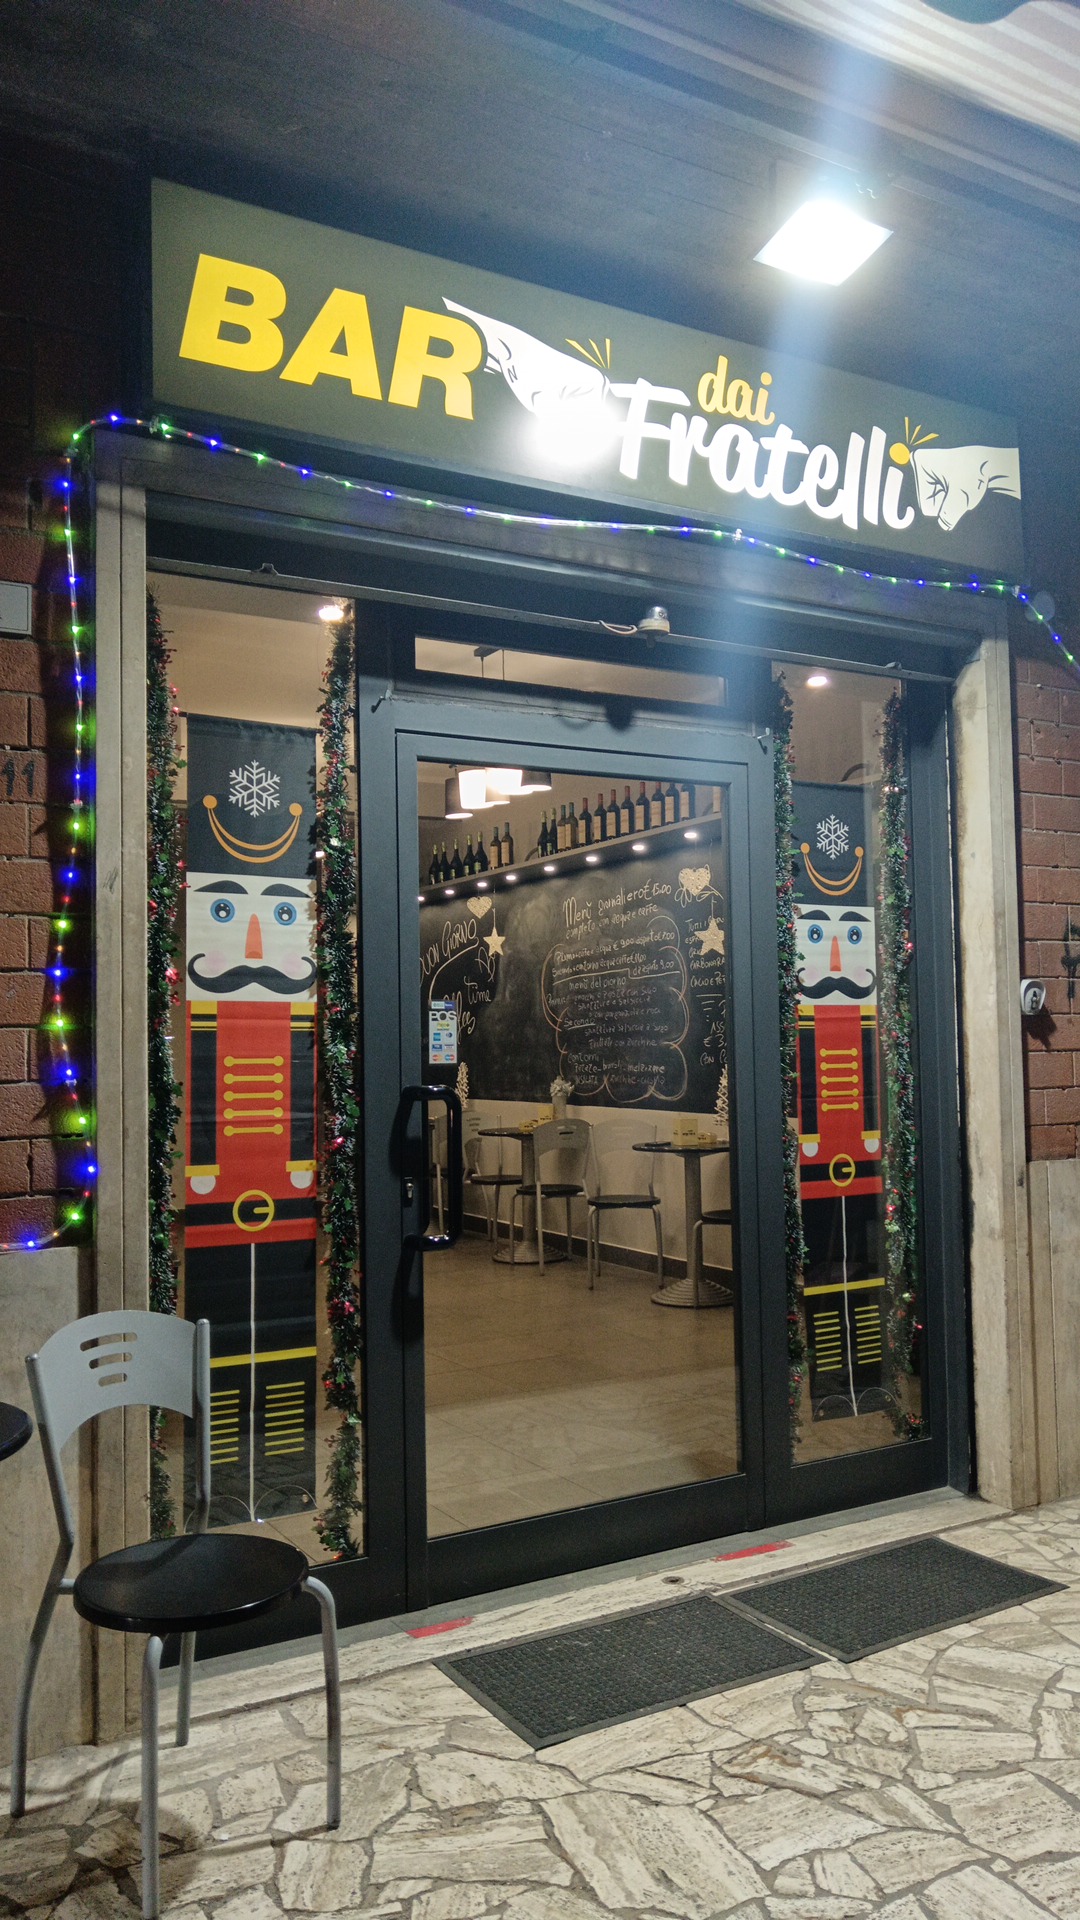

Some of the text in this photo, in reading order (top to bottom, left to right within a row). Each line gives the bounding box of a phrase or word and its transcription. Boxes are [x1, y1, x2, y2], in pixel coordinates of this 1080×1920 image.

[179, 253, 484, 420] BAR
[697, 355, 775, 425] dai
[608, 377, 916, 530] Fratelli
[431, 1010, 457, 1022] POS
